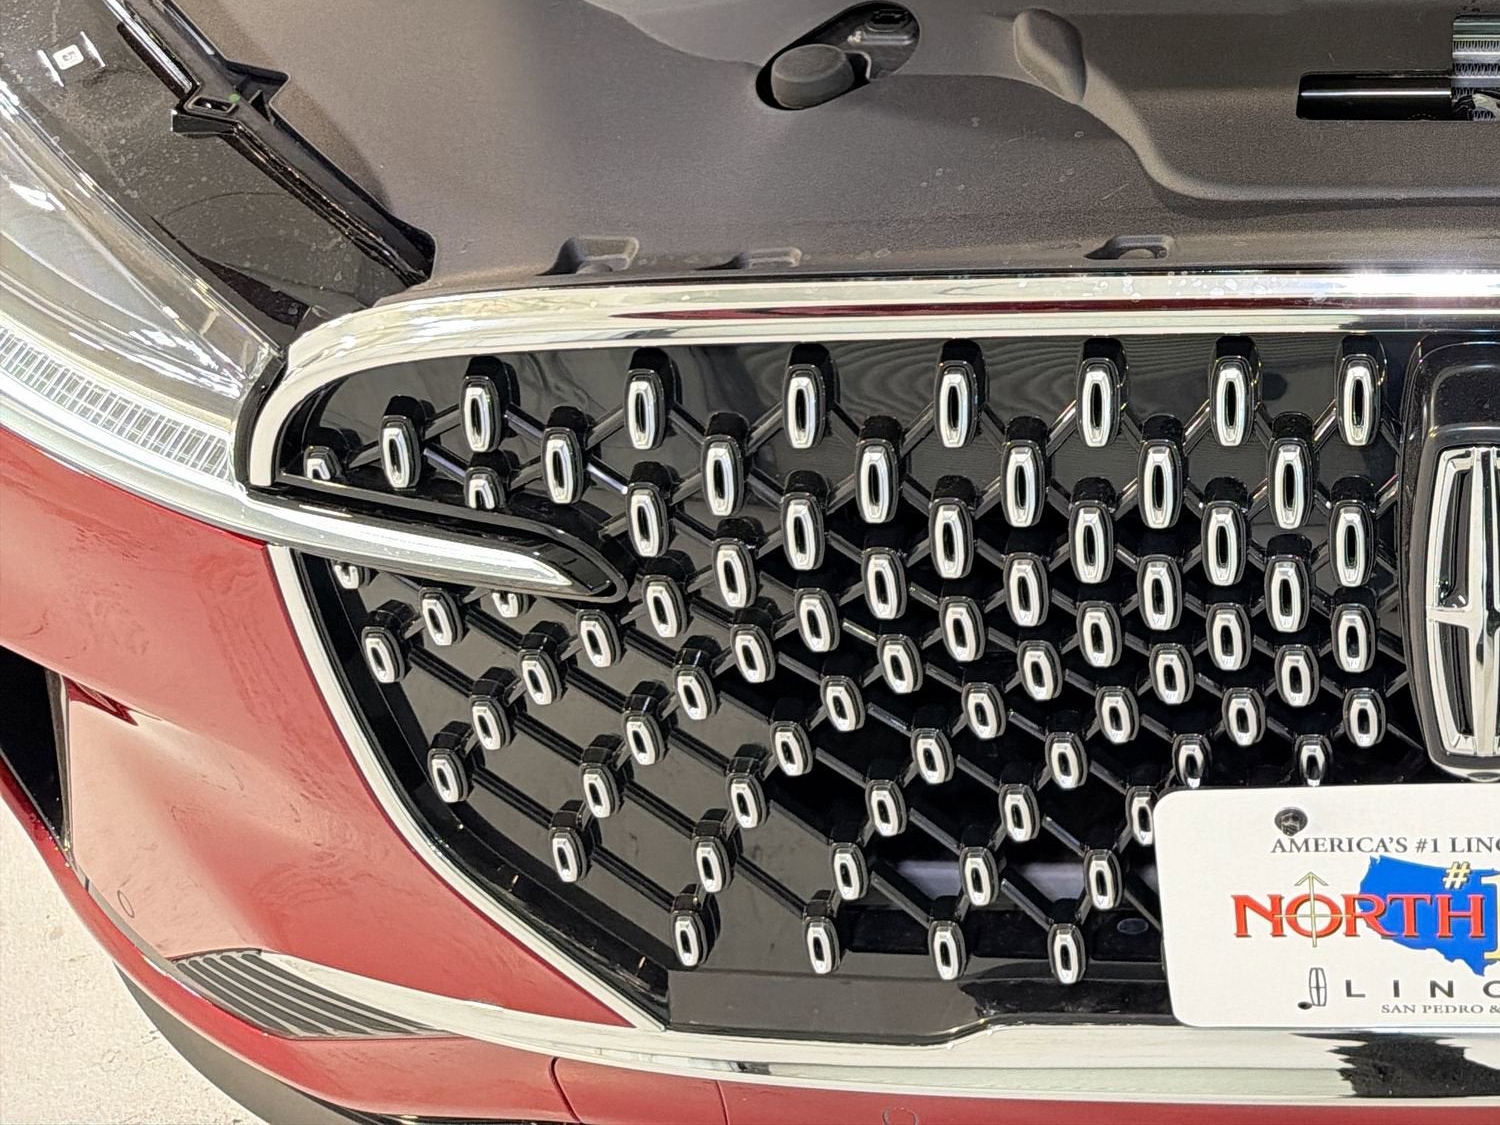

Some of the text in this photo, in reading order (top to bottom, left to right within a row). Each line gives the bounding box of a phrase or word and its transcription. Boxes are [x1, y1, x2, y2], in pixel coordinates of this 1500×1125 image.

[1270, 836, 1408, 854] AMERICA'S
[1415, 837, 1440, 854] #1
[1231, 893, 1485, 938] NORTH
[1381, 1004, 1419, 1014] SAN
[1423, 1004, 1484, 1014] PEDRO
